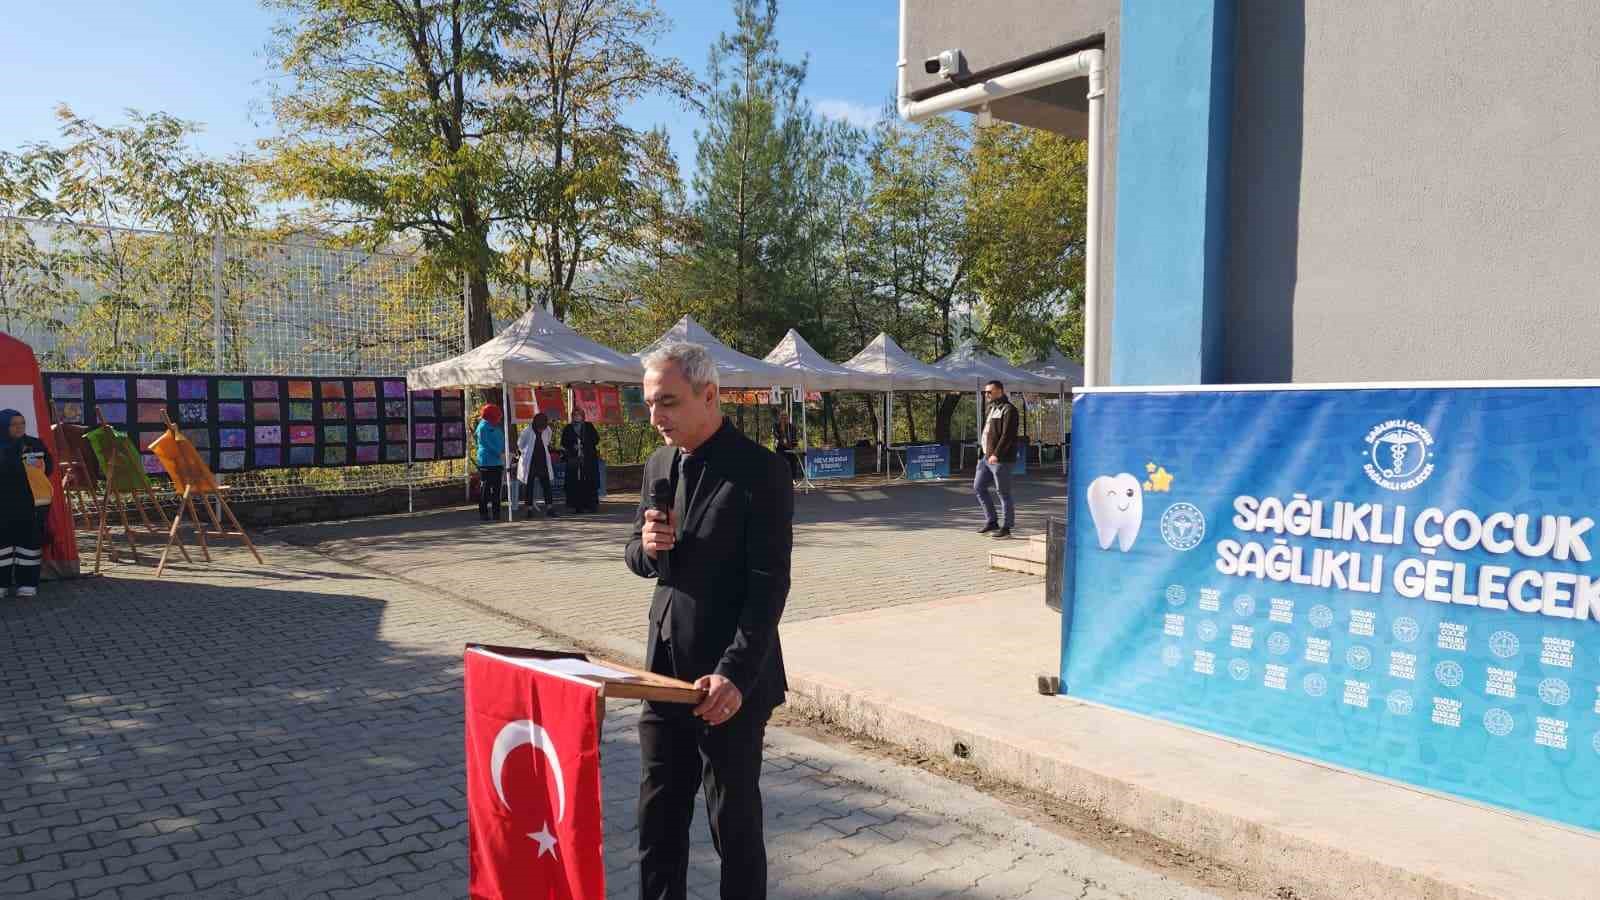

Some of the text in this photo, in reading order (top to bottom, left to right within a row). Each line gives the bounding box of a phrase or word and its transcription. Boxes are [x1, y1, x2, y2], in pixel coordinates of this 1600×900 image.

[1233, 493, 1406, 545] SAĞLIKLI
[1413, 508, 1595, 562] ÇOCUK
[1215, 538, 1600, 622] SAĞLIKLI GELECEK
